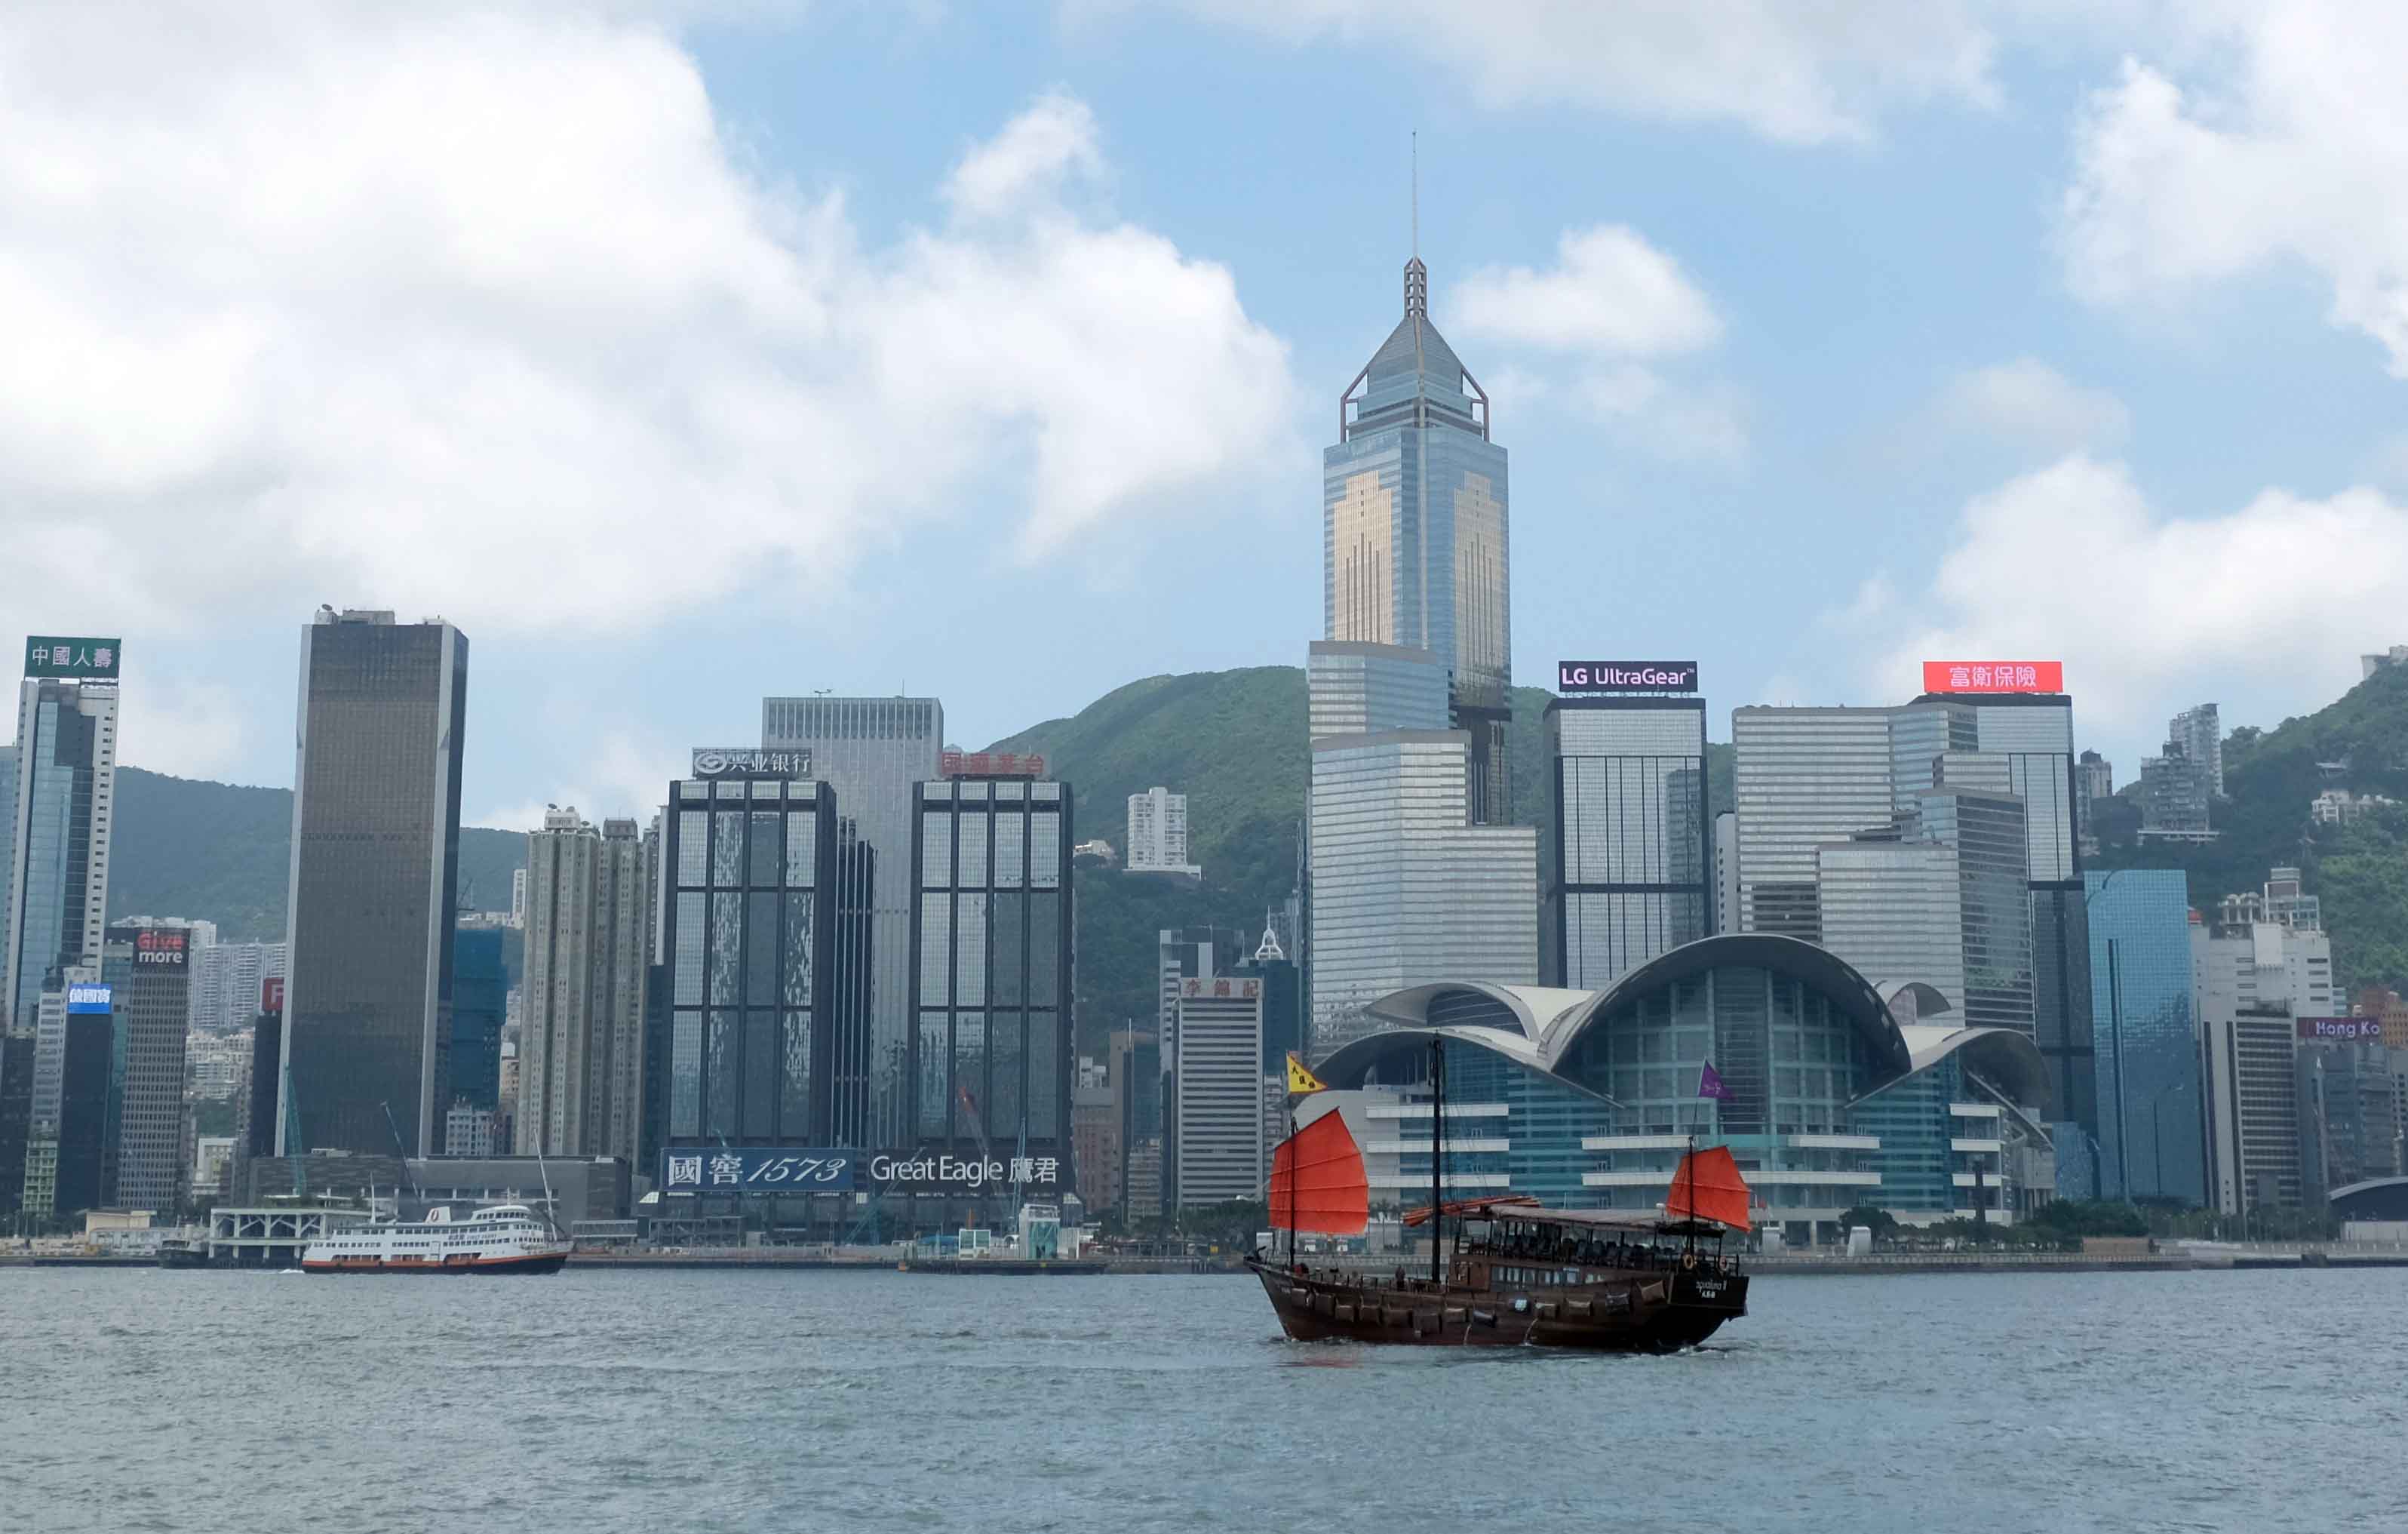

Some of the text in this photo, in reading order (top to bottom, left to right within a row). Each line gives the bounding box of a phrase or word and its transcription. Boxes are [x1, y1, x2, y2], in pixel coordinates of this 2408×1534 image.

[32, 645, 112, 668] 中國人壽
[1562, 668, 1588, 685] LG
[1949, 666, 2037, 688] 富衛保險
[726, 753, 810, 773] 兴业银行
[138, 951, 183, 964] more
[2316, 1021, 2356, 1038] Hong
[871, 1155, 936, 1181] Great
[939, 1154, 1003, 1188] Eagle
